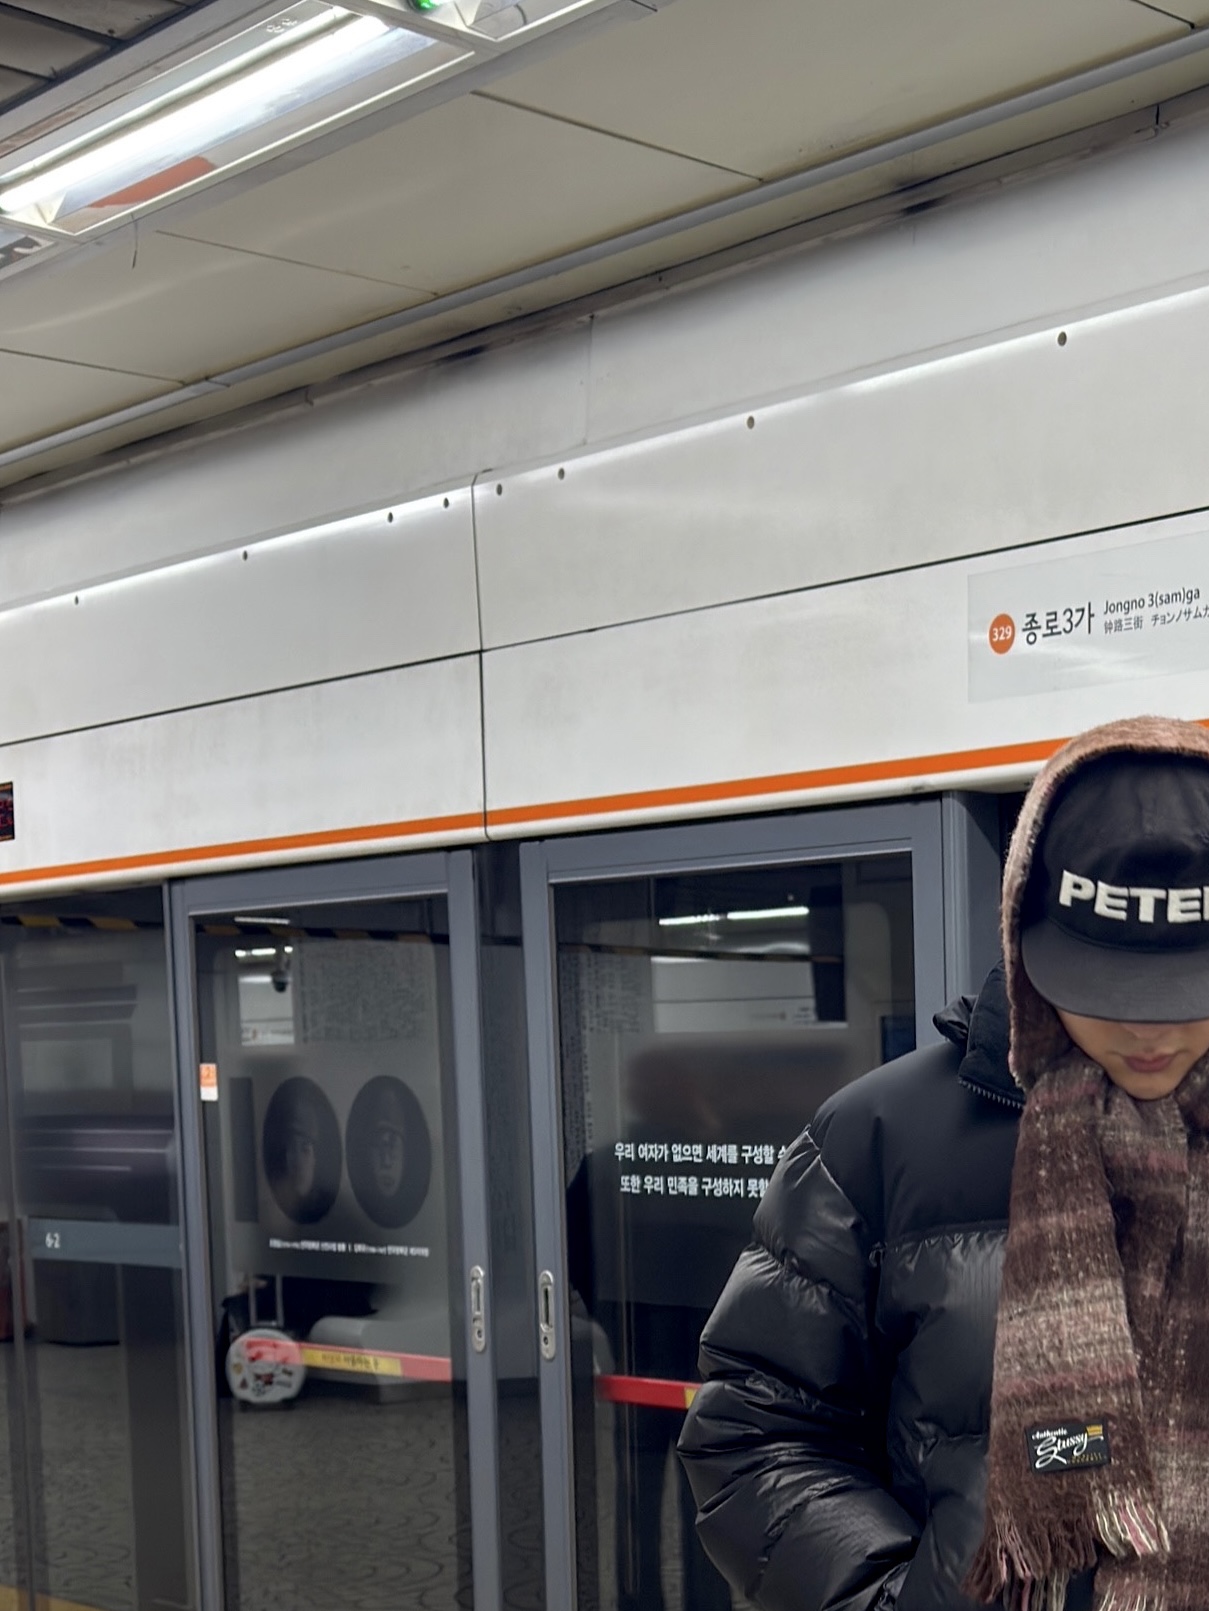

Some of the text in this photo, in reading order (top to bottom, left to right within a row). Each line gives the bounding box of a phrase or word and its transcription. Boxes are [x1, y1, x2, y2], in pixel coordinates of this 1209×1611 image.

[1103, 587, 1201, 615] Jongno 3(sam)ga
[992, 625, 1012, 641] 329
[1022, 601, 1095, 645] 종로3가
[614, 1142, 635, 1161] 우리
[638, 1143, 669, 1163] 여자가
[671, 1143, 703, 1163] 없으면
[706, 1144, 738, 1165] 세계를
[741, 1145, 775, 1165] 구성할
[620, 1174, 641, 1194] 또한
[643, 1175, 664, 1195] 우리
[701, 1177, 744, 1198] 구성하지
